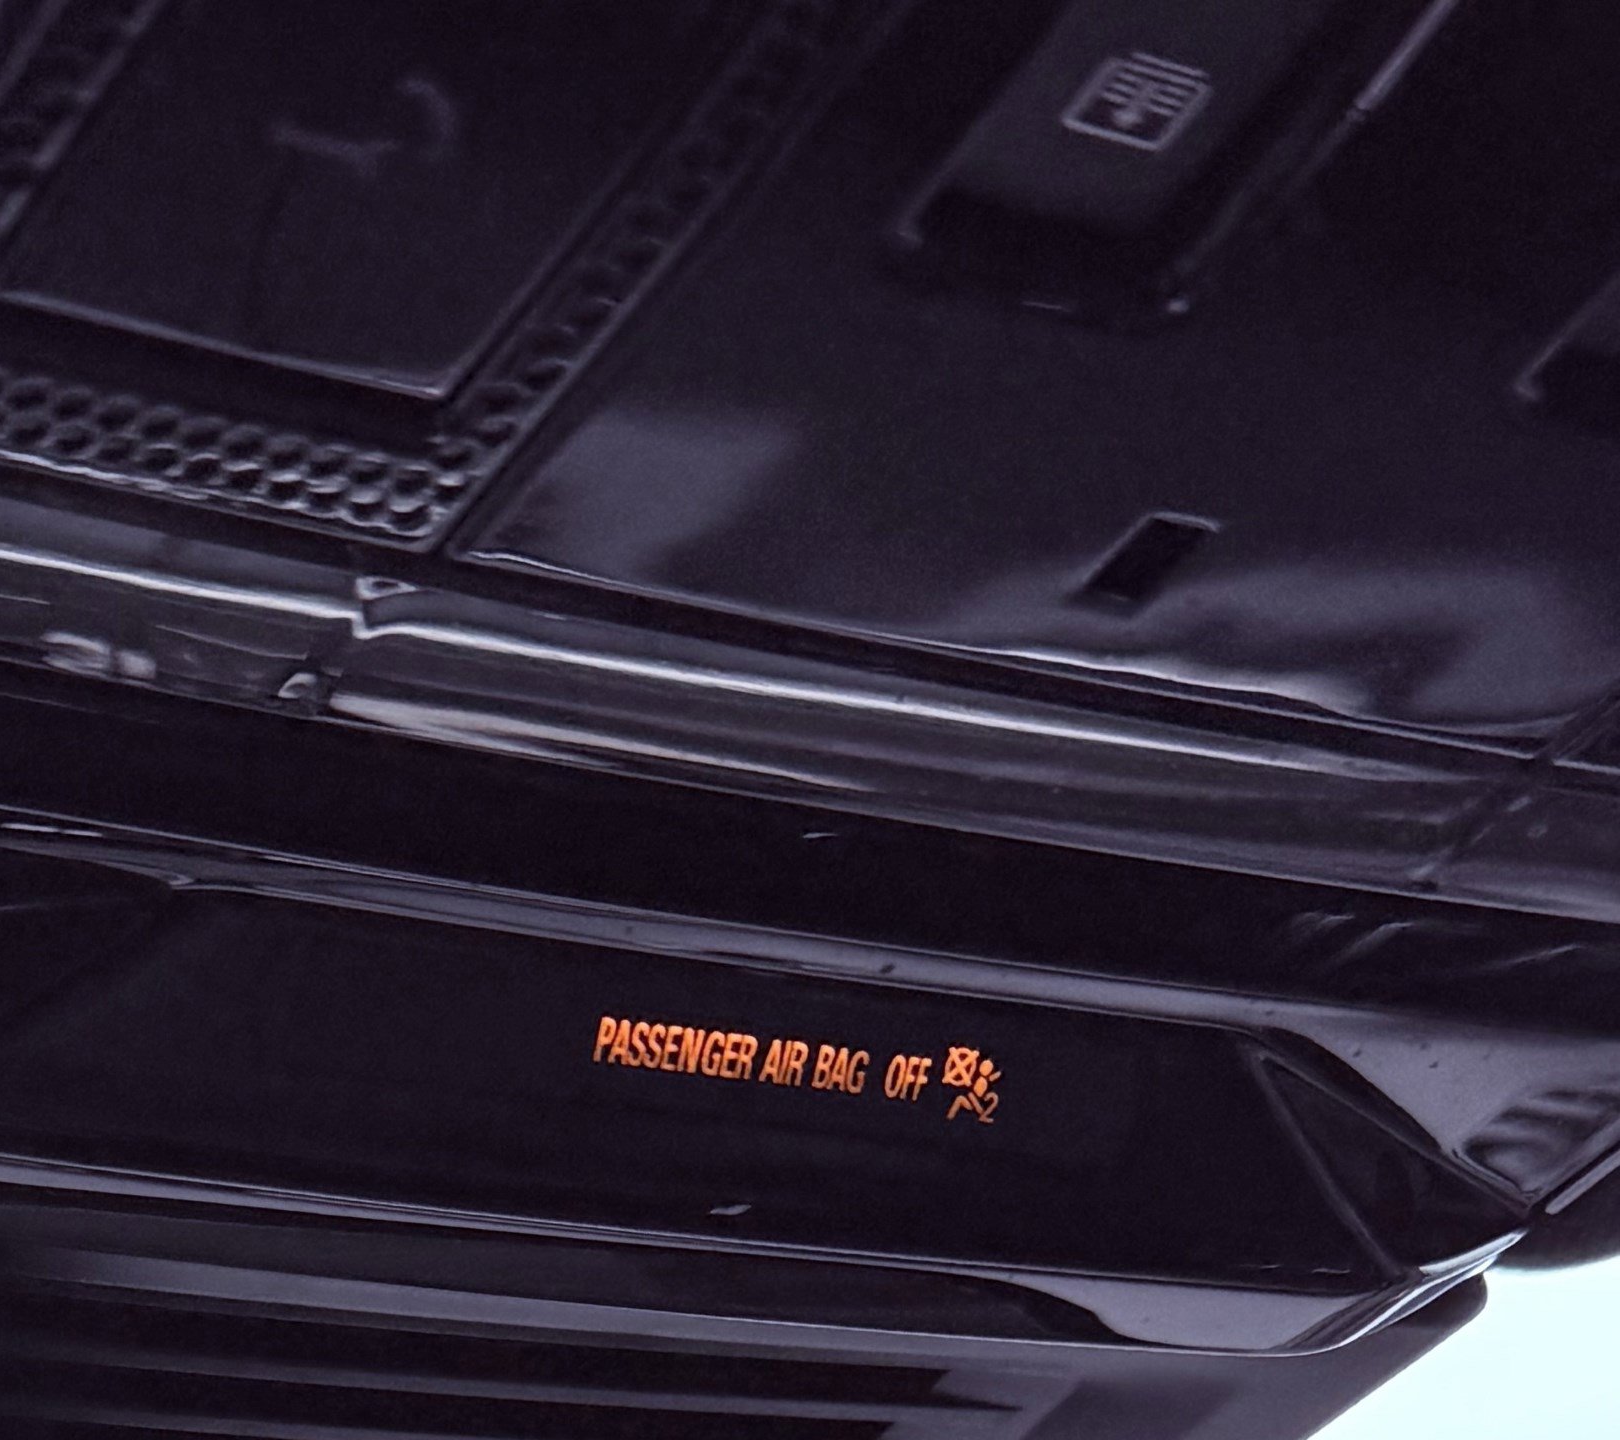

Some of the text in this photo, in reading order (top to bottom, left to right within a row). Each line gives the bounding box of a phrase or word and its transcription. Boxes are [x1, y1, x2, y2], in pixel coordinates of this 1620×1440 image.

[593, 1016, 933, 1100] PASSENGER AIR BAG OFF
